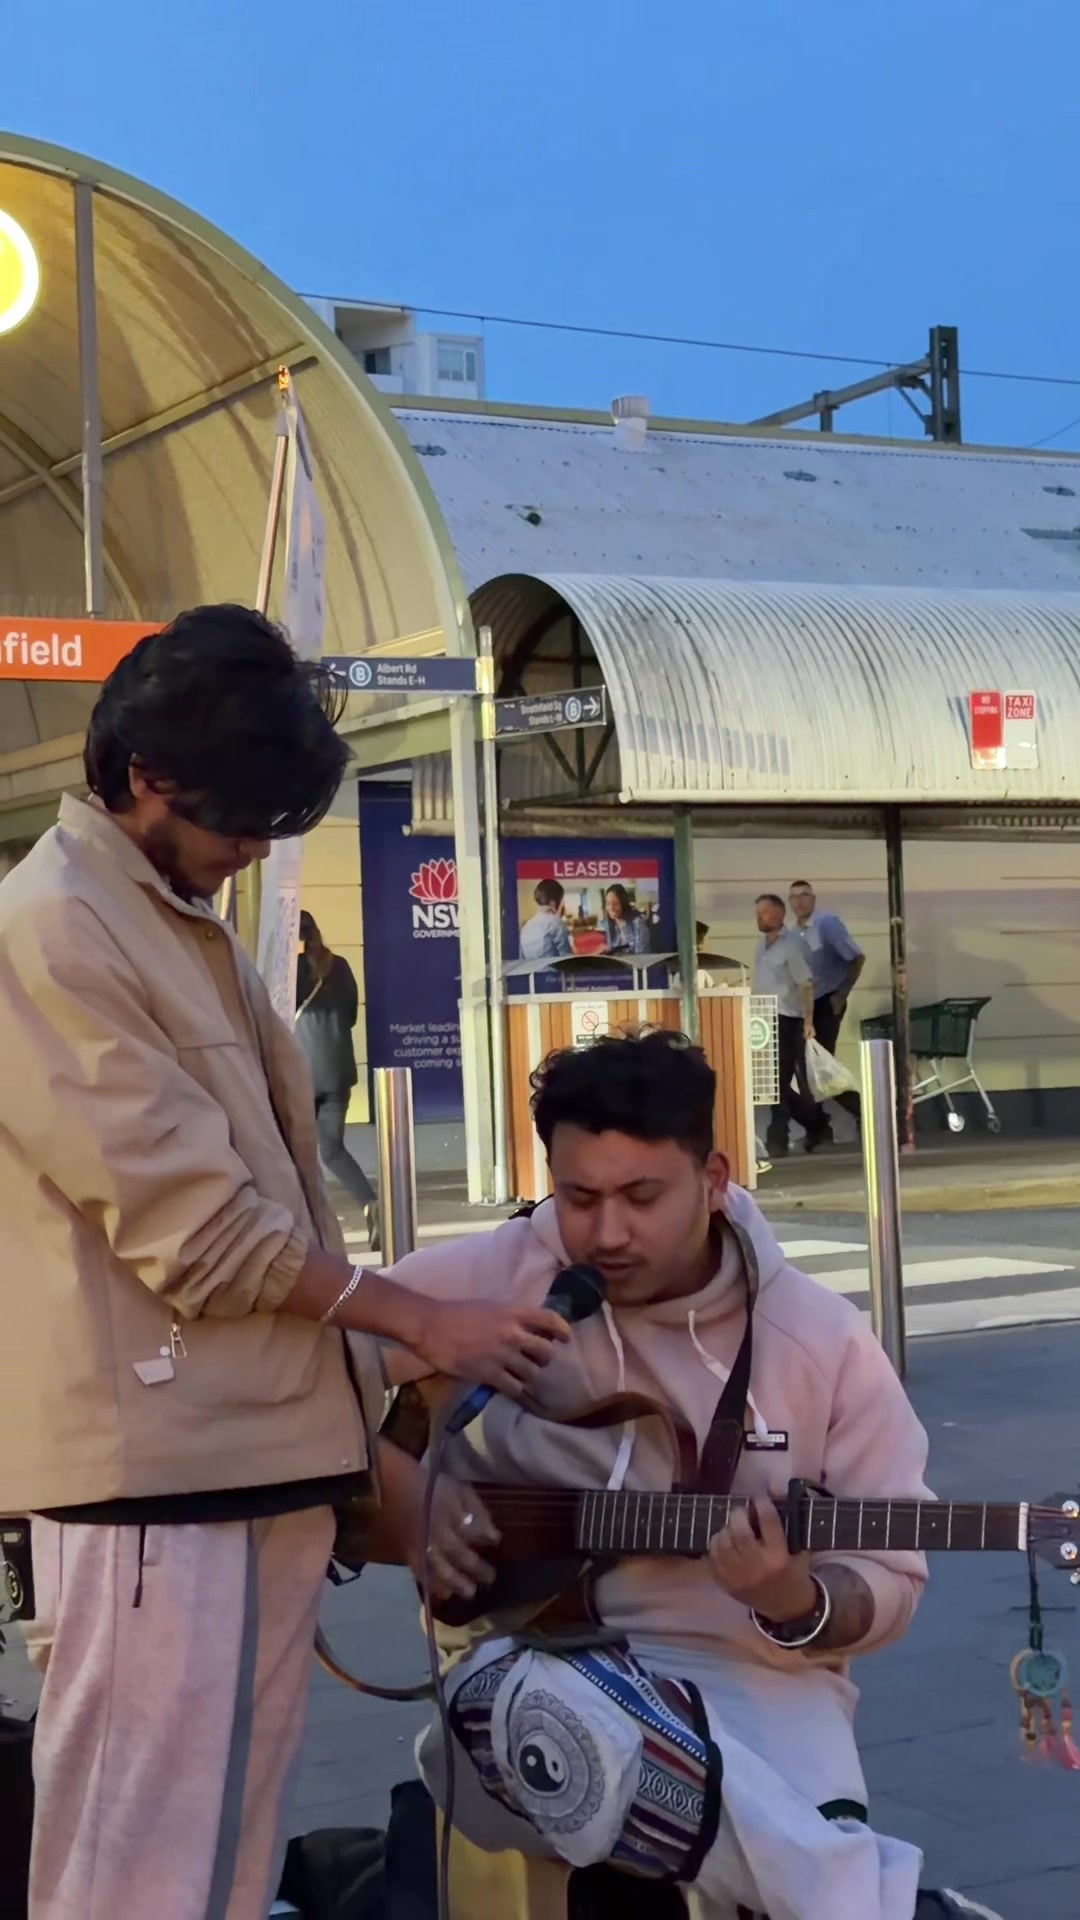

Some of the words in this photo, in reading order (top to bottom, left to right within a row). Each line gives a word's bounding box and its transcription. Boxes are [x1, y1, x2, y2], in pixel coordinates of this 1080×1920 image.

[1, 632, 82, 666] field
[376, 664, 404, 674] Albert
[405, 664, 417, 674] Rd
[377, 675, 407, 685] Stands
[408, 675, 425, 685] E-H
[1007, 696, 1032, 707] TAXI
[1007, 707, 1032, 718] ZONE
[553, 861, 621, 877] LEASED
[413, 929, 460, 939] GOVERNME
[389, 1023, 426, 1033] Market
[428, 1022, 460, 1033] leadin
[402, 1035, 439, 1046] driving
[441, 1036, 449, 1044] a
[394, 1047, 443, 1057] customer
[446, 1048, 461, 1058] exp
[414, 1058, 453, 1069] coming
[455, 1058, 462, 1067] s
